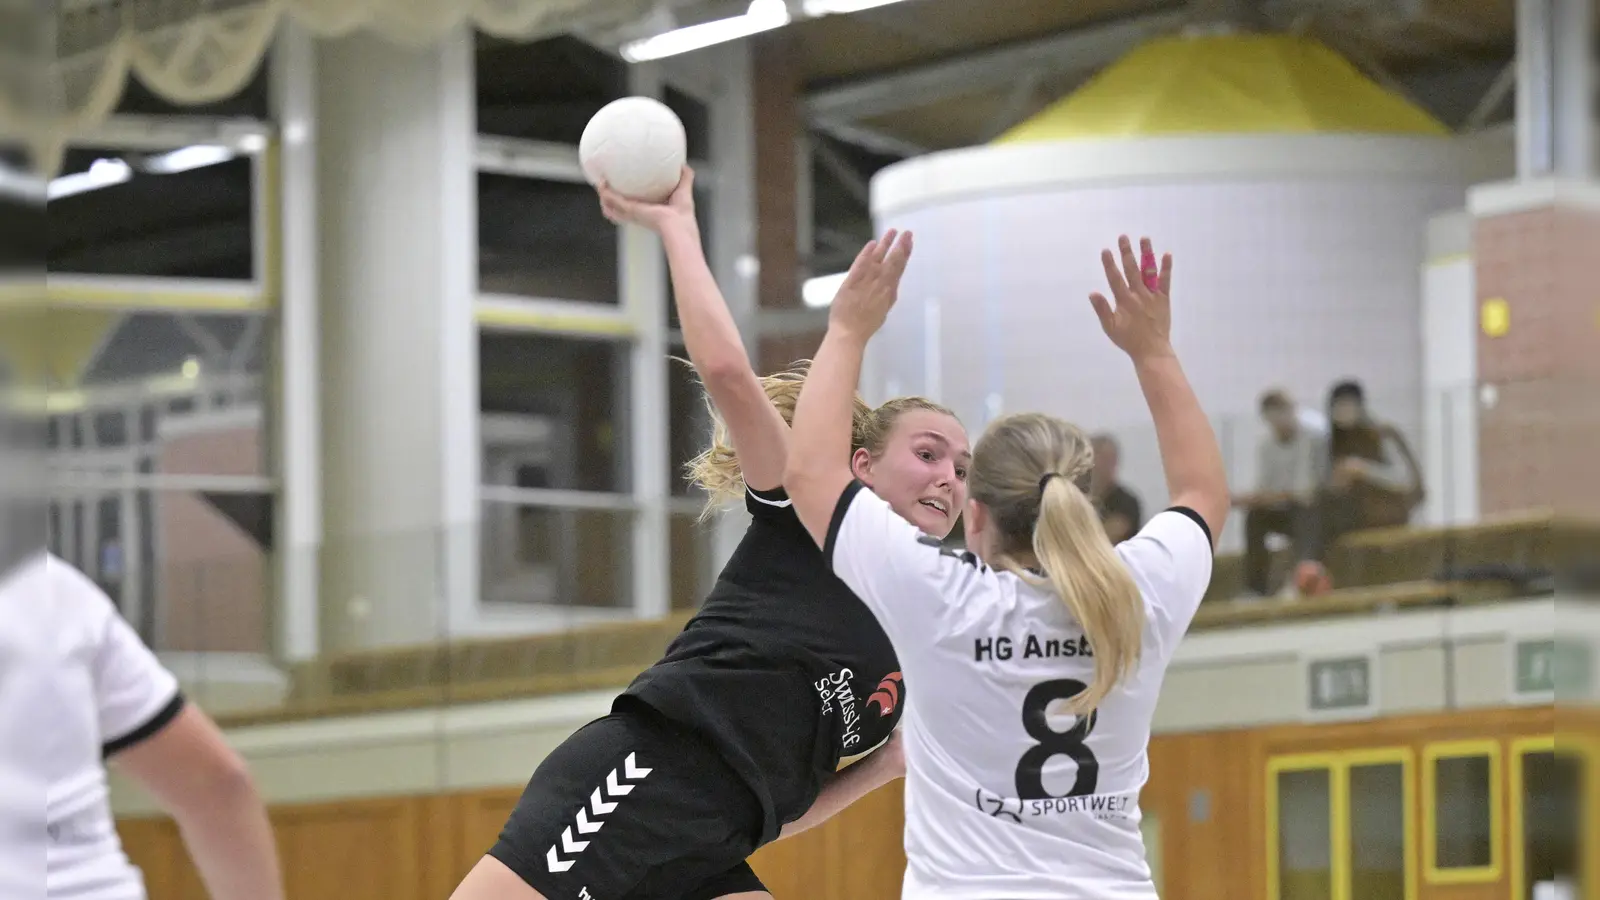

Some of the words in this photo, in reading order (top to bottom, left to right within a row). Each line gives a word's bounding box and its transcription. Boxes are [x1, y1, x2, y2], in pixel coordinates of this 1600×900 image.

[975, 637, 1012, 661] HG
[1023, 635, 1094, 659] Ansb
[829, 668, 861, 748] SwissLif
[1015, 678, 1099, 800] 8
[1031, 796, 1128, 816] SPORTWELT
